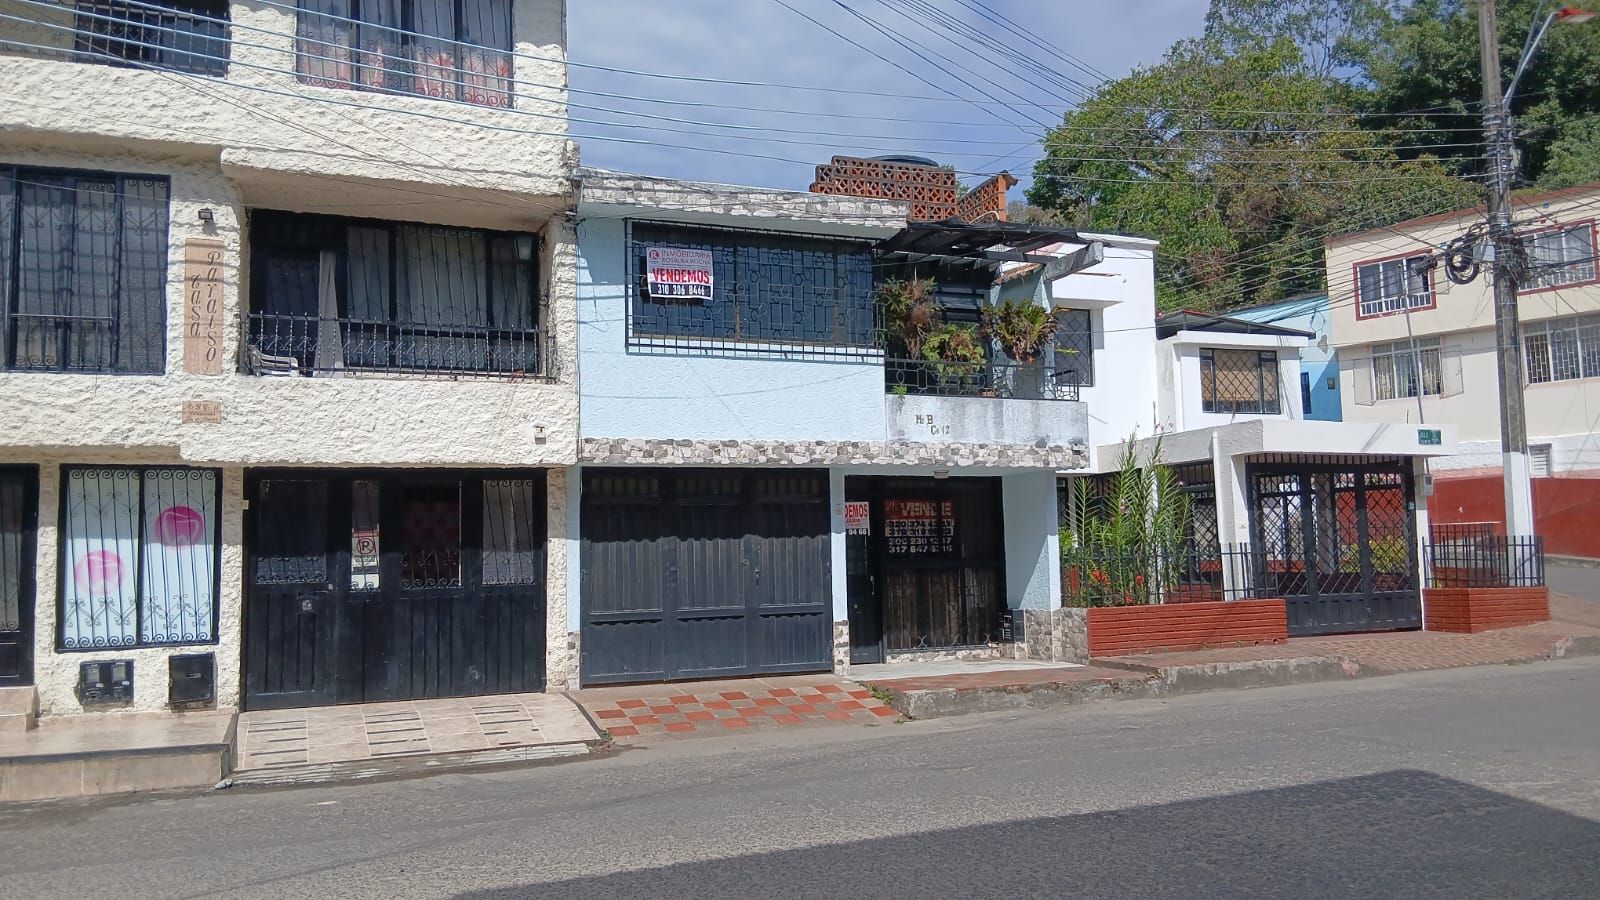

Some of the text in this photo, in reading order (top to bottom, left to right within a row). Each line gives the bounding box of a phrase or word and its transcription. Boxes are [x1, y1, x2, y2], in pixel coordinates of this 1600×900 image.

[652, 267, 710, 284] VENDEMOS
[657, 284, 669, 295] 310
[926, 414, 934, 425] B
[845, 504, 868, 518] DEMOS
